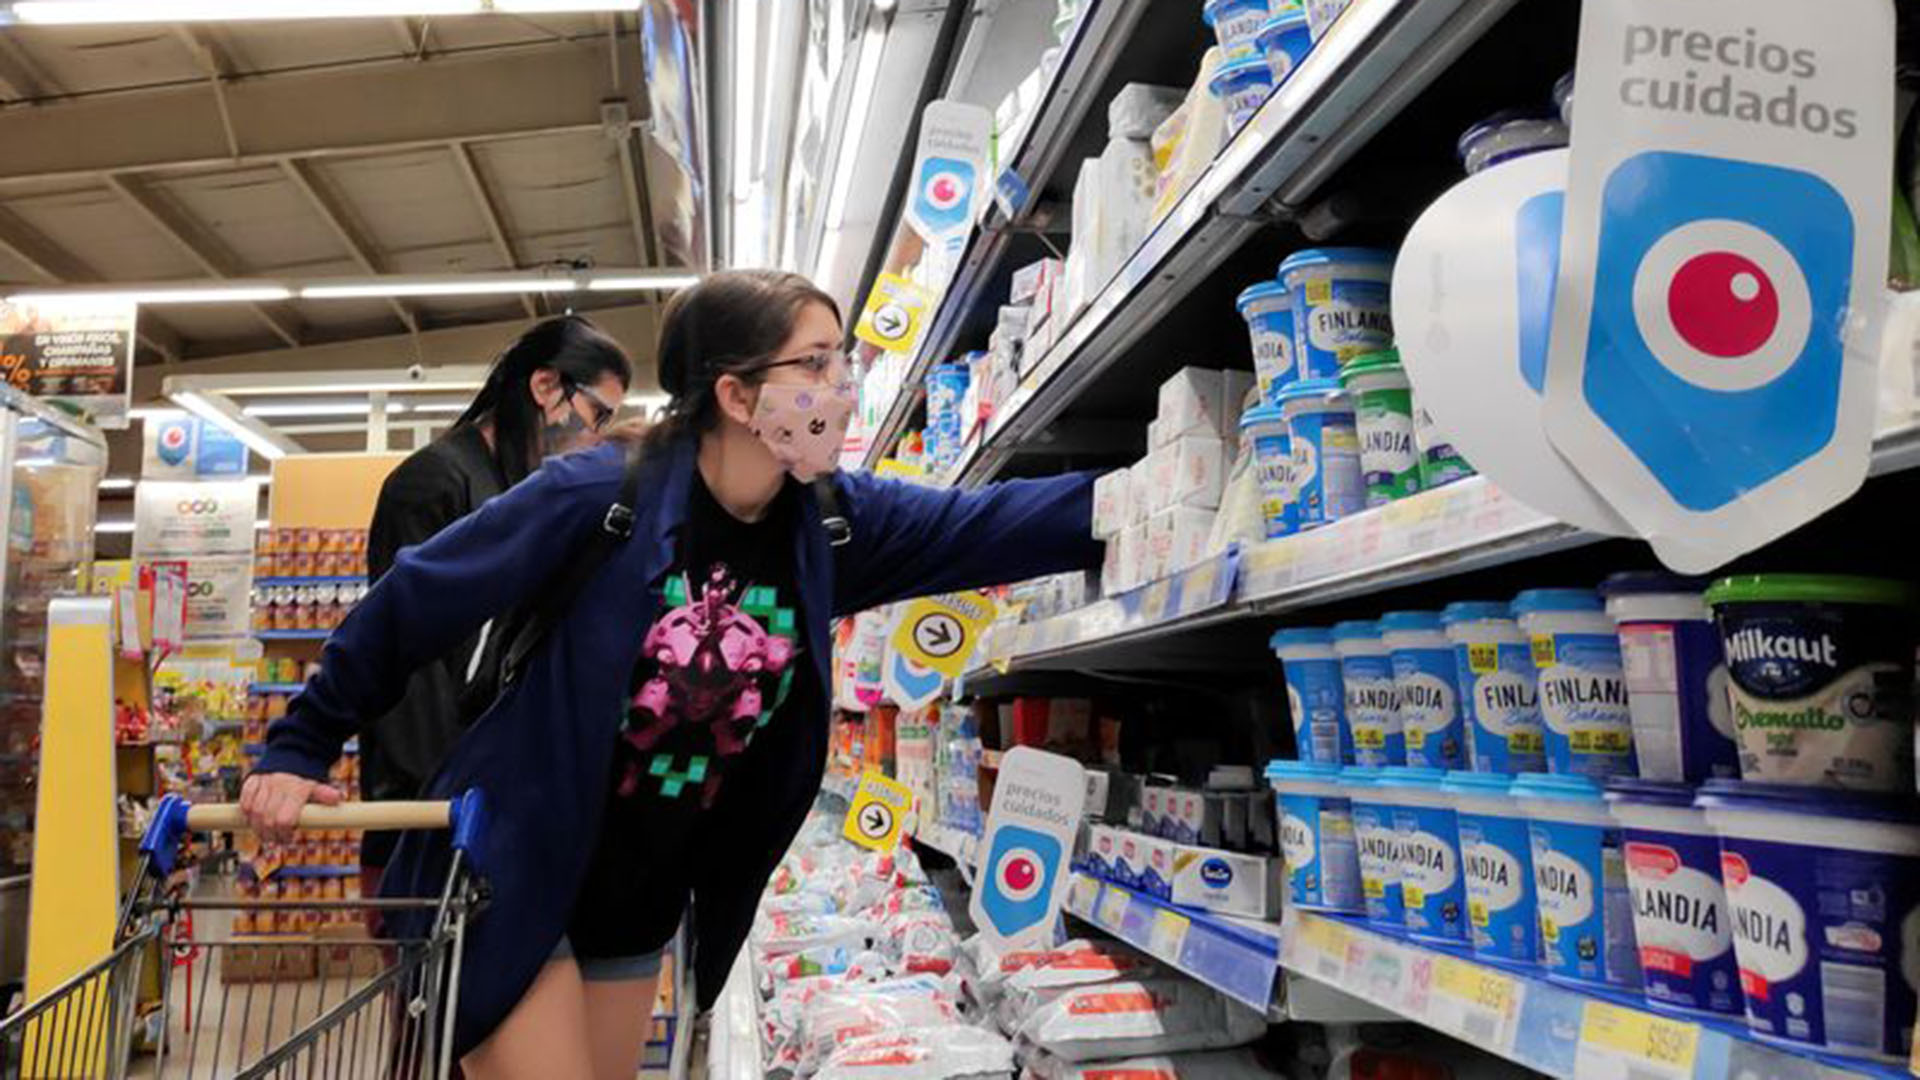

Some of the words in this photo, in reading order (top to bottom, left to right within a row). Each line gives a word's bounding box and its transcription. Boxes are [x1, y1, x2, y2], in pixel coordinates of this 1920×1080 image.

[1623, 23, 1816, 79] precios
[1619, 70, 1857, 139] cuidados
[1725, 627, 1838, 668] Milkaut
[1002, 799, 1069, 827] cuidados
[1005, 783, 1061, 807] precios
